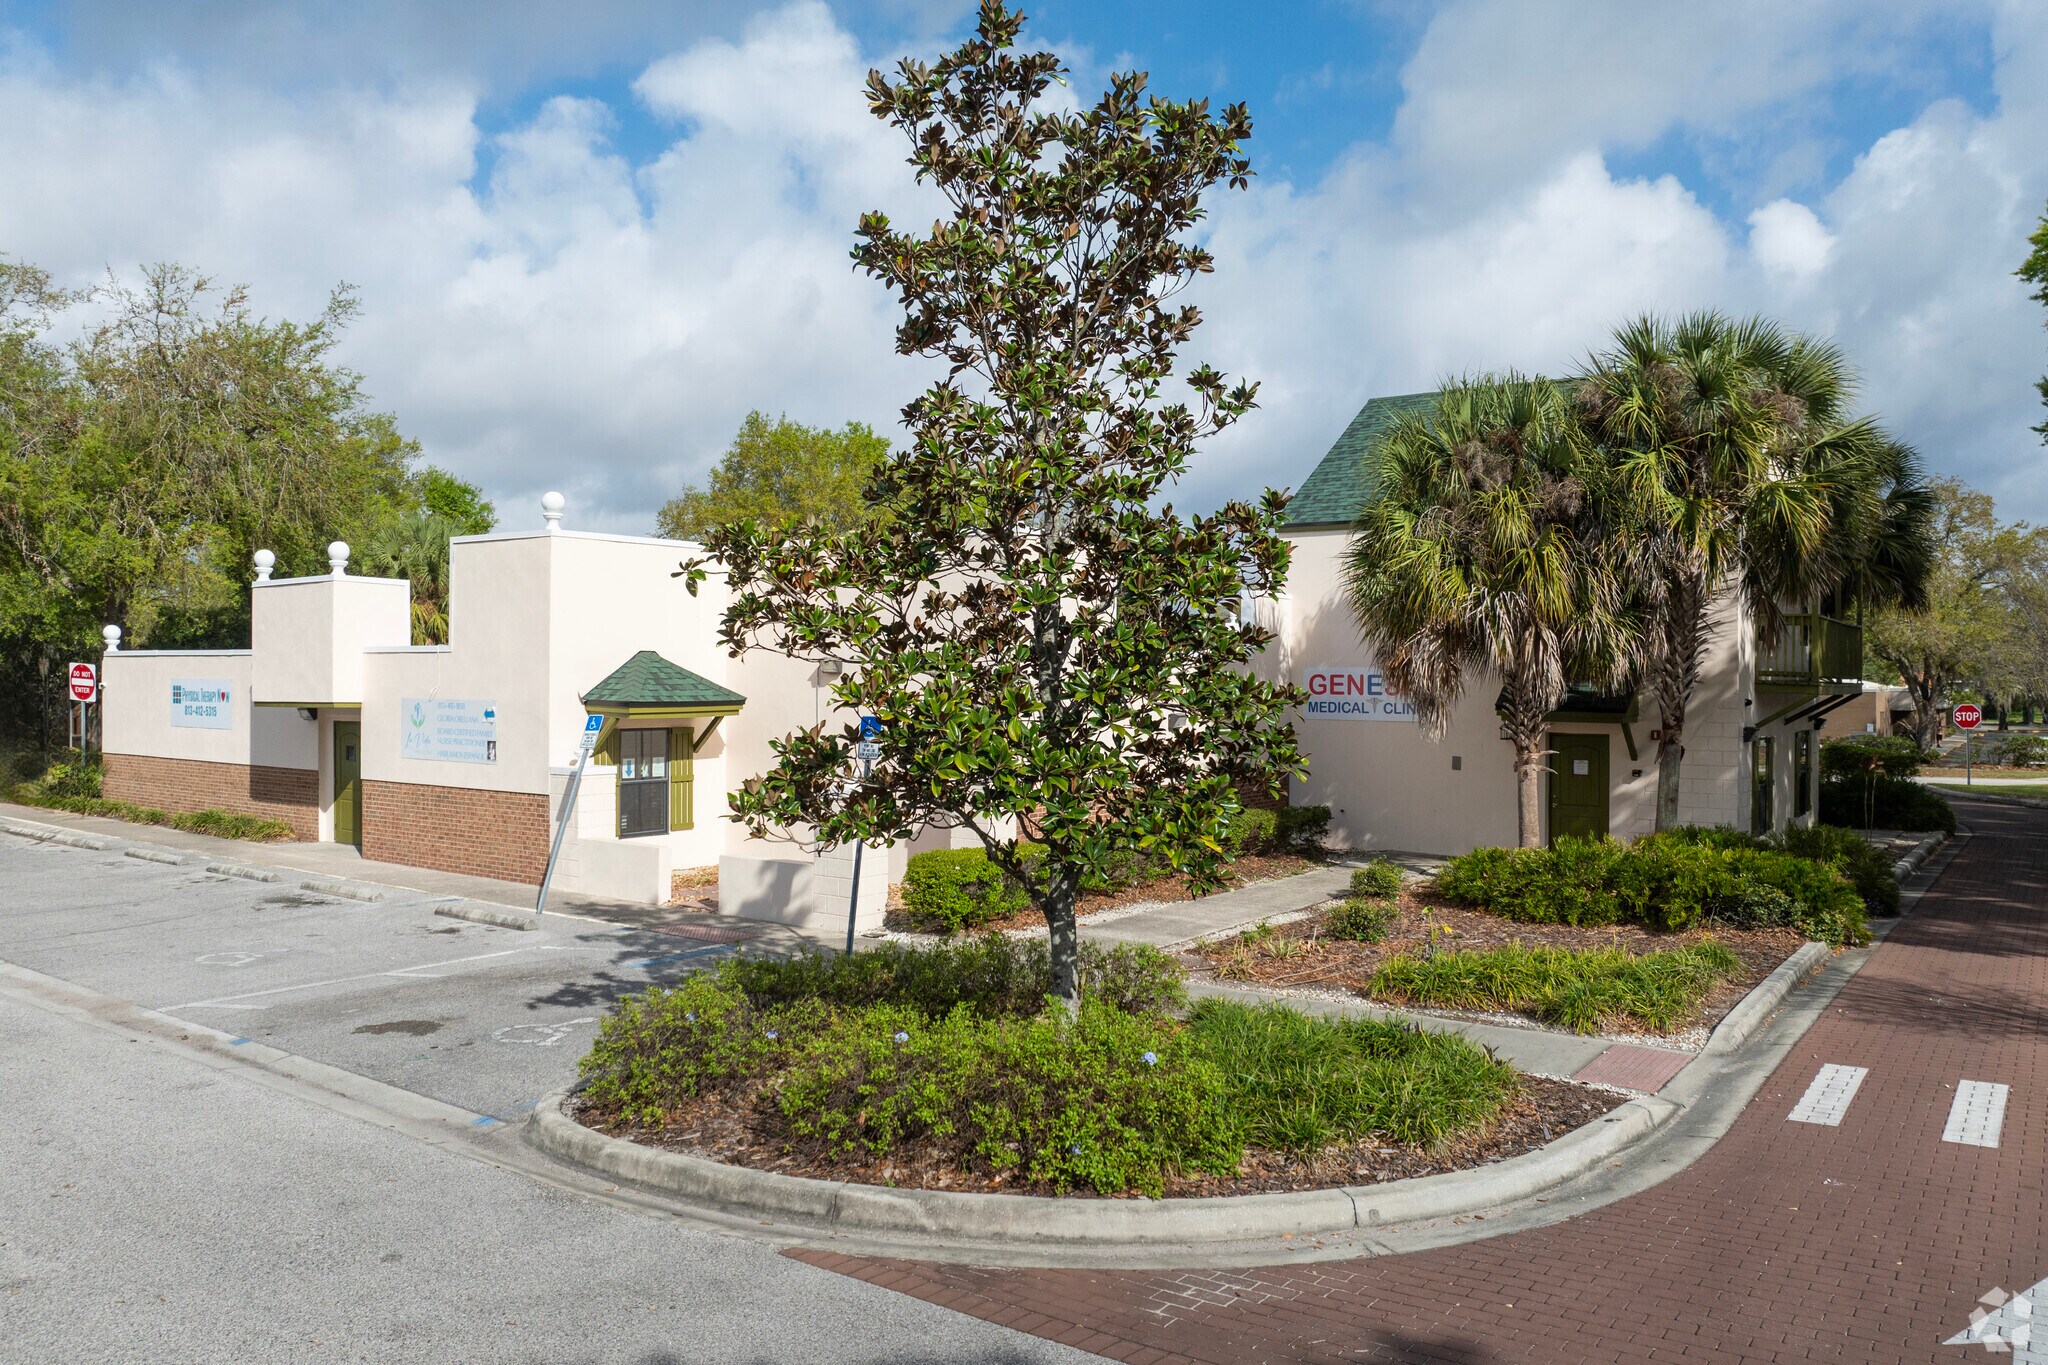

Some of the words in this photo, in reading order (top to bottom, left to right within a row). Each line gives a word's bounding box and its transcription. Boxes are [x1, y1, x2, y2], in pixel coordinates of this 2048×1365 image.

[1309, 673, 1400, 696] GENES
[184, 705, 217, 717] 813-412-5315
[1308, 701, 1369, 714] MEDICAL
[1383, 702, 1417, 715] CLIN
[1955, 711, 1980, 722] STOP
[437, 727, 454, 735] BOARD
[454, 728, 476, 736] CERTIFIED
[477, 729, 493, 737] FAMILY
[453, 738, 486, 747] PRACTITIONER
